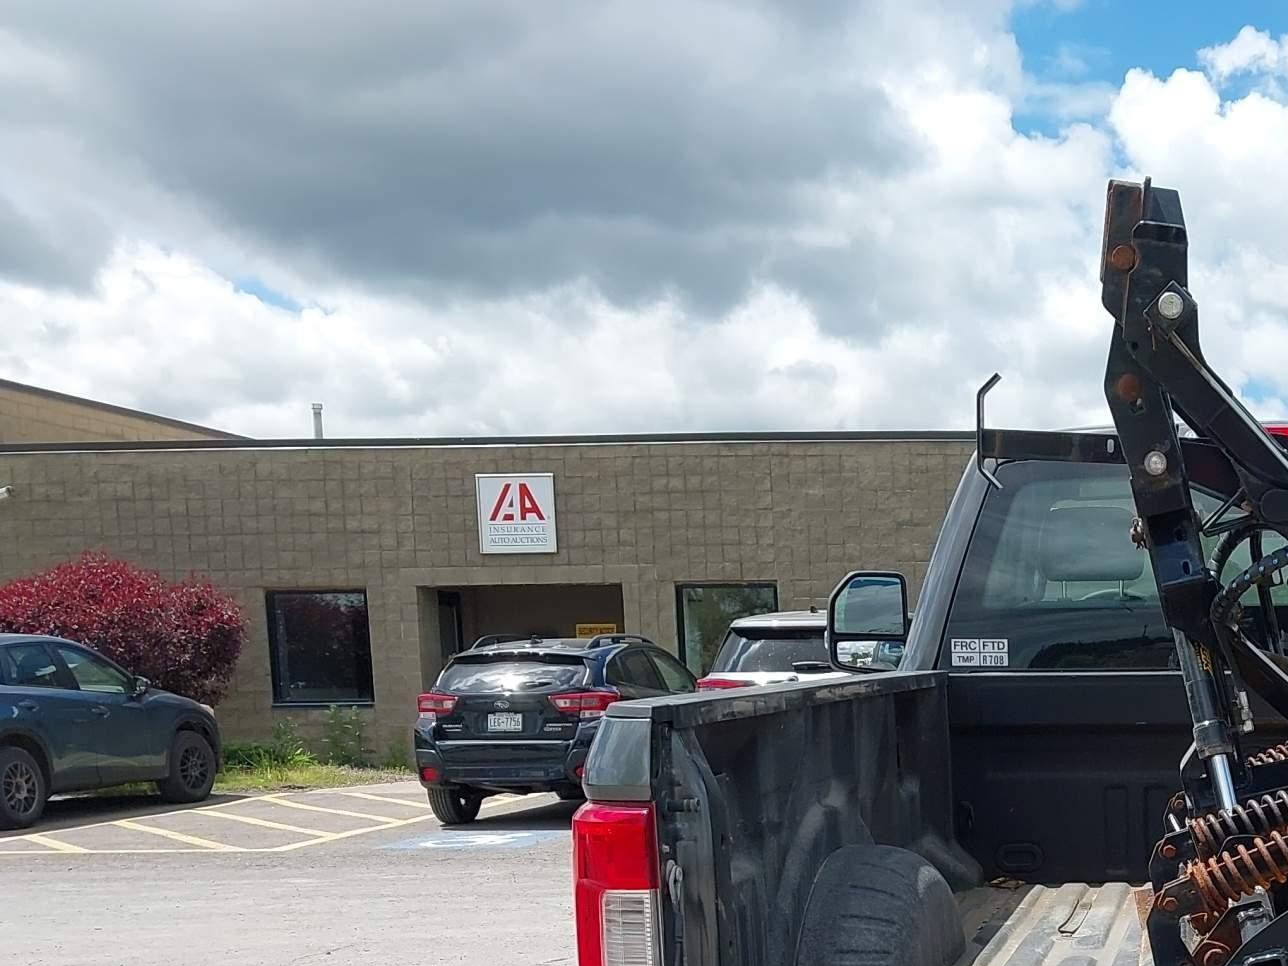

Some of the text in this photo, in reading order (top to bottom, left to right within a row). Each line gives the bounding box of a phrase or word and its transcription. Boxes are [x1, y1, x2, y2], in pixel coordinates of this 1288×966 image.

[489, 525, 547, 533] INSURANCE
[490, 536, 548, 544] AUTO AUCTIONS
[953, 640, 977, 651] FRC
[982, 640, 1006, 651] FTD
[982, 655, 1005, 665] R708
